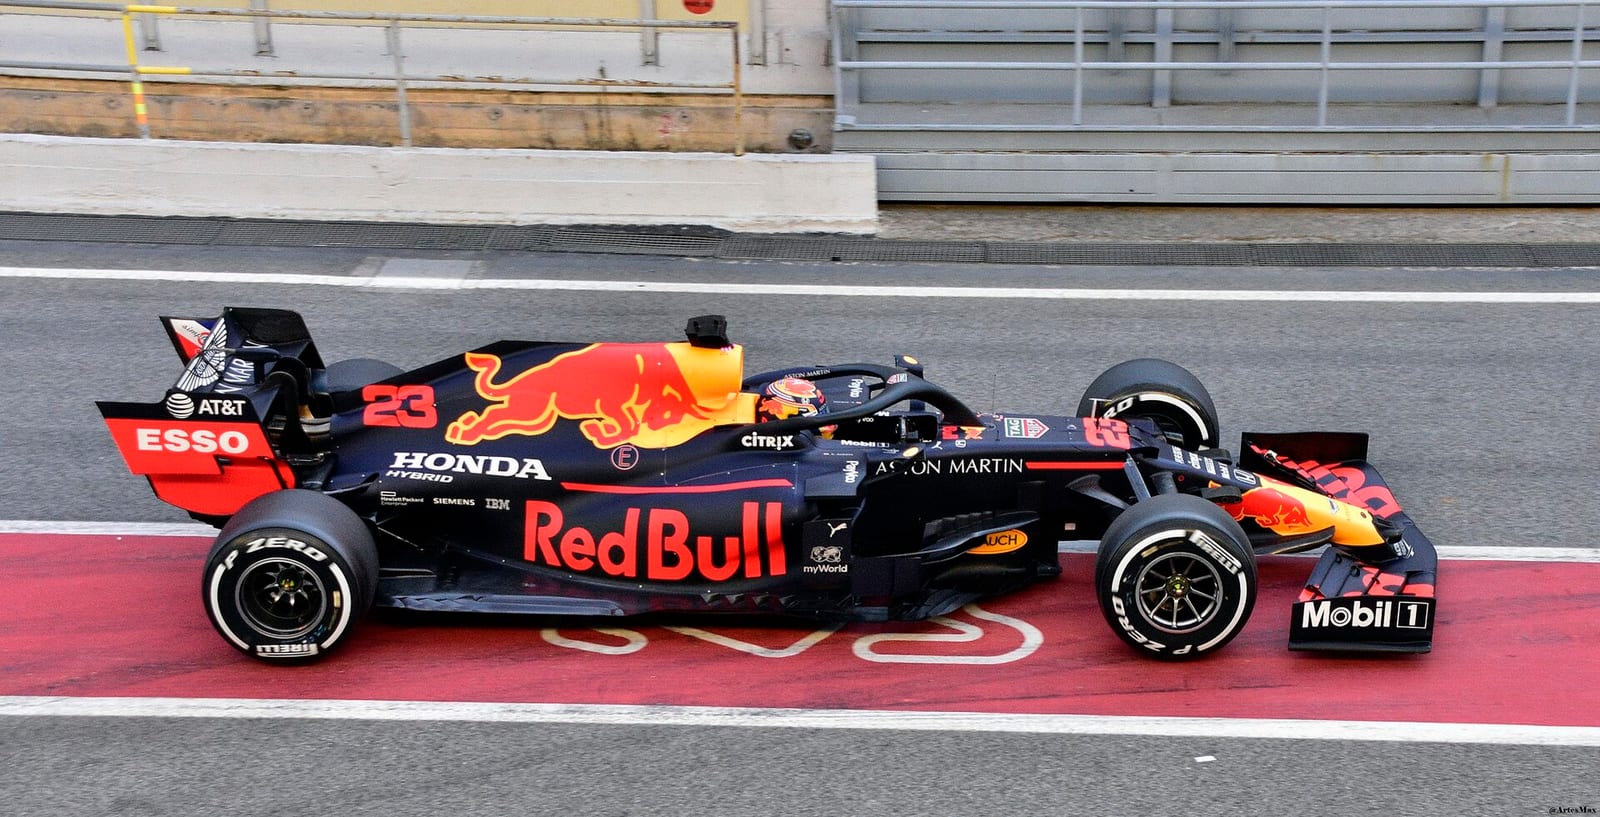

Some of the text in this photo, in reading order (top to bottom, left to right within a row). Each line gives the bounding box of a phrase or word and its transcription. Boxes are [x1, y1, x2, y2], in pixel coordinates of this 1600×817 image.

[806, 368, 831, 377] MARTIN
[198, 399, 246, 416] AT&T
[362, 384, 438, 429] 23
[136, 428, 249, 454] ESSO
[840, 439, 876, 448] Mobil
[389, 452, 552, 481] HONDA
[875, 458, 1023, 476] ASON MARTIN
[386, 470, 454, 483] HYBRID
[433, 498, 476, 506] SIEMENS
[485, 498, 511, 511] IBM
[524, 499, 787, 582] Red Bull
[985, 534, 1018, 547] UCH
[246, 537, 328, 562] ZERO
[803, 564, 848, 574] myWorld
[1112, 594, 1167, 652] ZERO
[1301, 600, 1393, 629] Mobil
